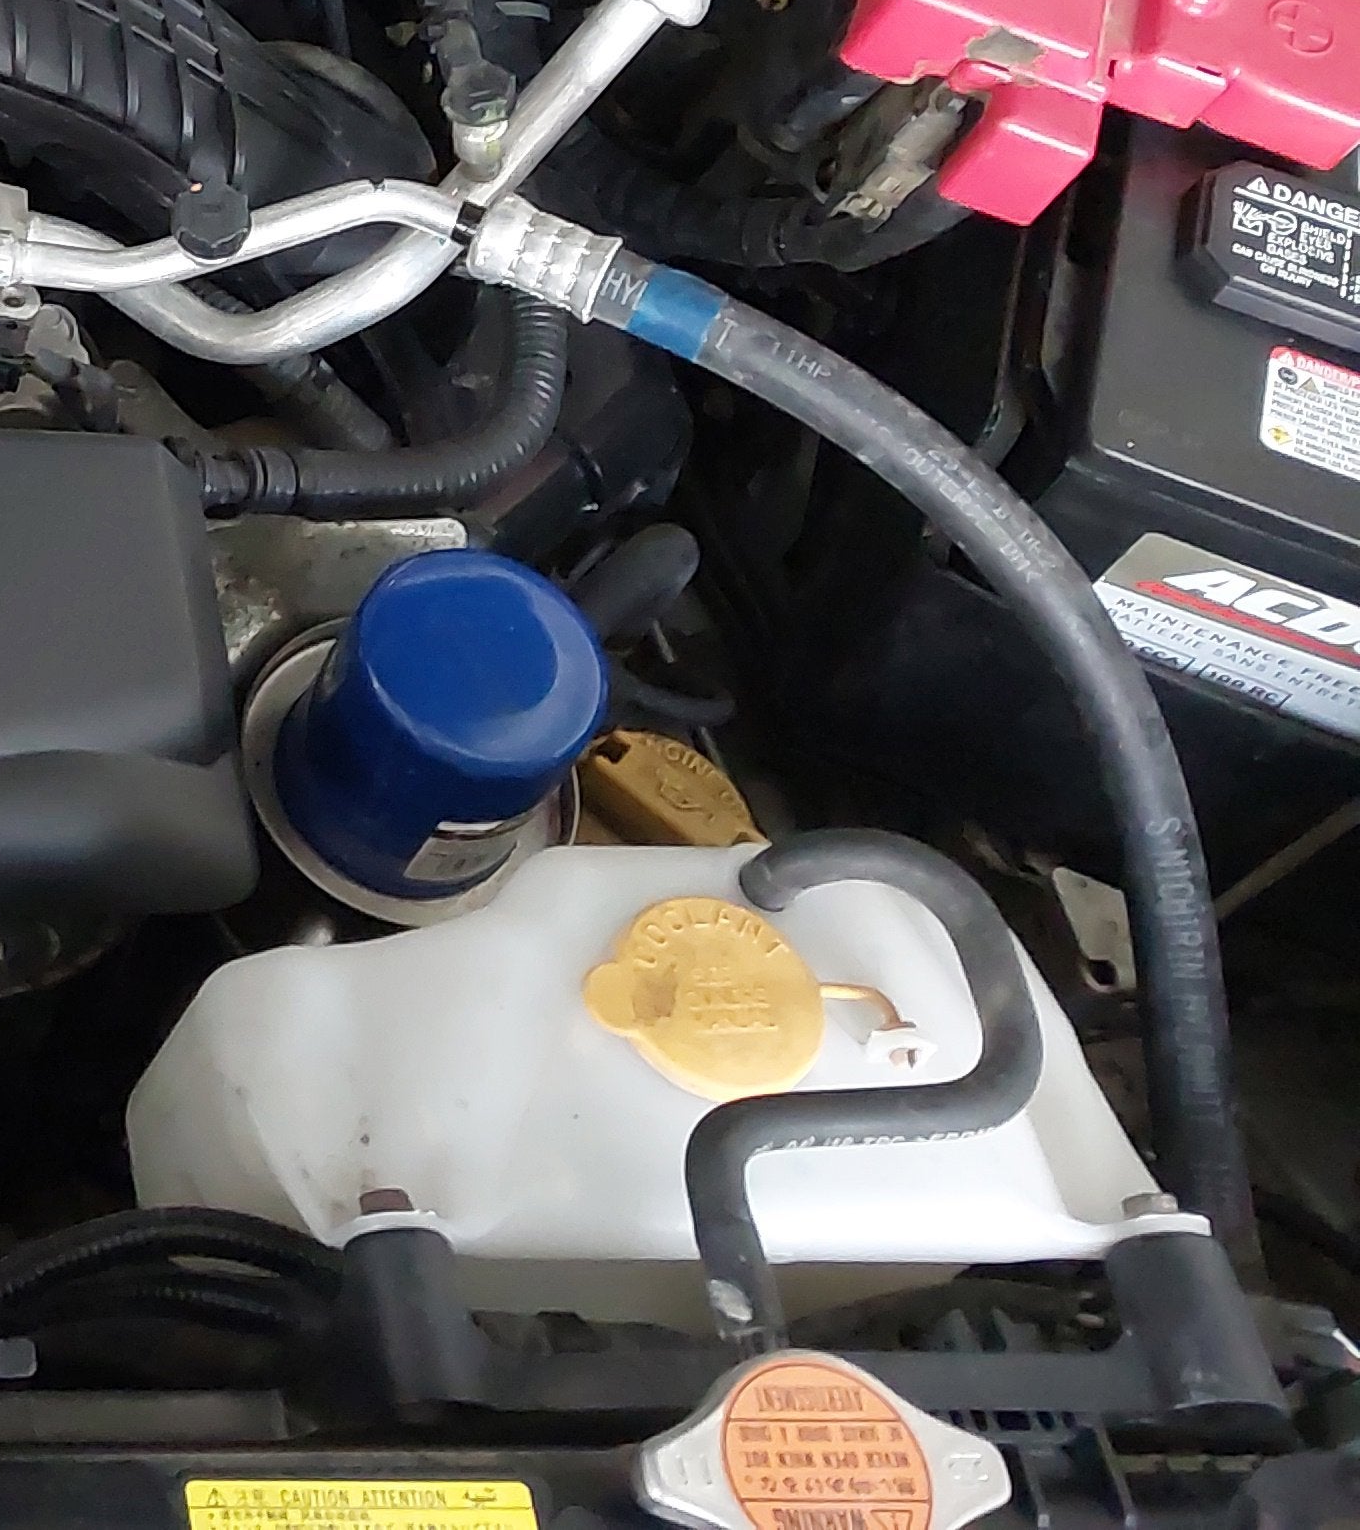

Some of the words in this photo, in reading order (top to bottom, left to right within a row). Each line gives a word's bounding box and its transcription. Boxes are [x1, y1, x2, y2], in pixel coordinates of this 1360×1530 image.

[1272, 182, 1360, 228] DANGE
[1115, 597, 1294, 667] MAINTENANCE
[1160, 568, 1360, 656] ACD
[1139, 646, 1181, 666] CCA
[1273, 669, 1360, 709] ENTRET
[279, 1488, 350, 1508] CAUTION
[361, 1488, 448, 1508] ATTENTION
